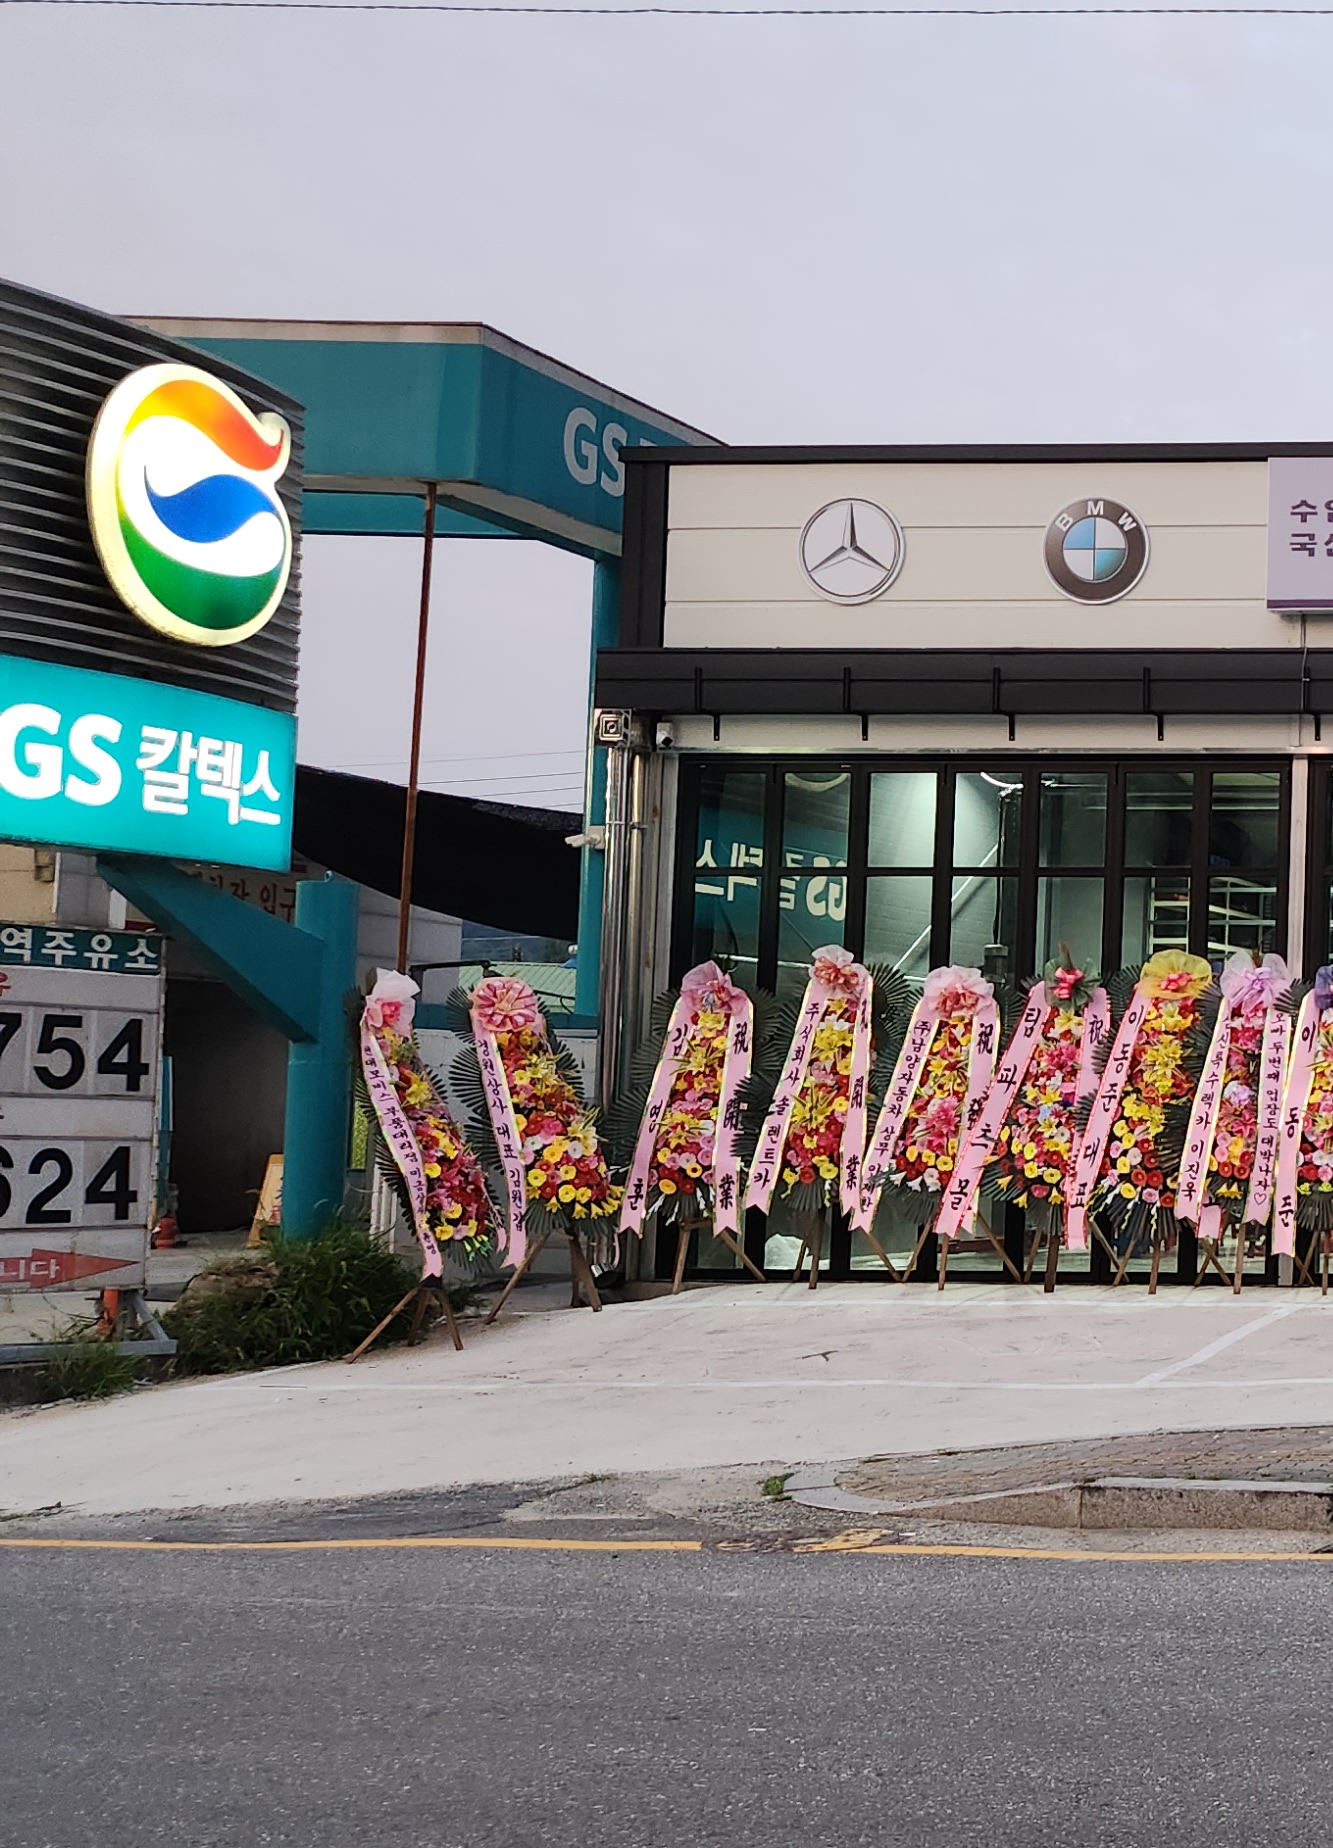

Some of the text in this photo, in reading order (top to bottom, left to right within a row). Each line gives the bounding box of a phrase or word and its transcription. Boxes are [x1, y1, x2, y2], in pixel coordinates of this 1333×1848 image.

[564, 408, 625, 497] GS
[1055, 500, 1138, 532] BMW
[0, 702, 281, 826] GS 칼텍스
[0, 926, 158, 970] 역주유소
[784, 1002, 820, 1086] 주식회사
[1101, 1007, 1144, 1112] 이동준
[384, 1107, 418, 1163] 부품대리점
[497, 1124, 518, 1159] 대표
[875, 1126, 895, 1156] 상무
[1278, 1020, 1317, 1228] 이동준
[1070, 1140, 1100, 1209] 대표
[1181, 1140, 1204, 1200] 이진욱
